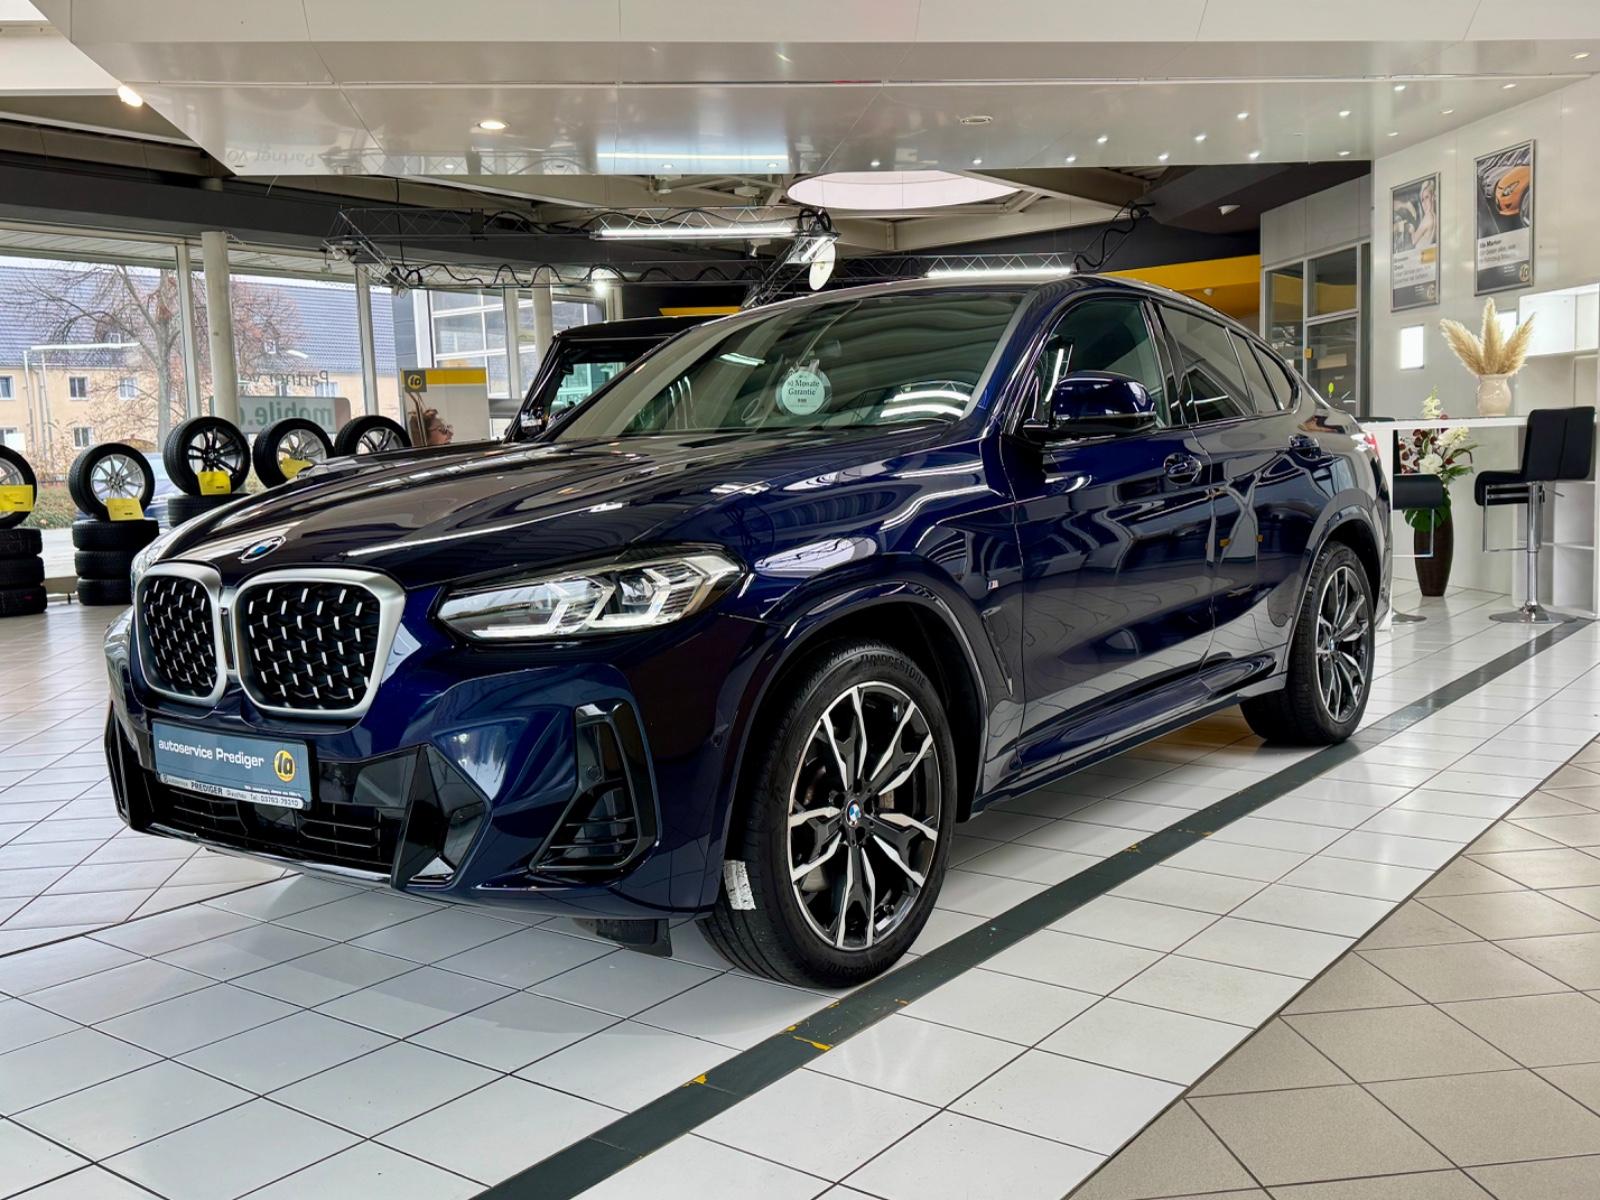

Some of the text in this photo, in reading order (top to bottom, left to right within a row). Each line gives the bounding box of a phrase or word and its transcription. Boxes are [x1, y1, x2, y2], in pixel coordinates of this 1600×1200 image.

[158, 738, 213, 761] autoservice
[216, 747, 265, 769] Prediger
[190, 781, 223, 796] PREDIGER
